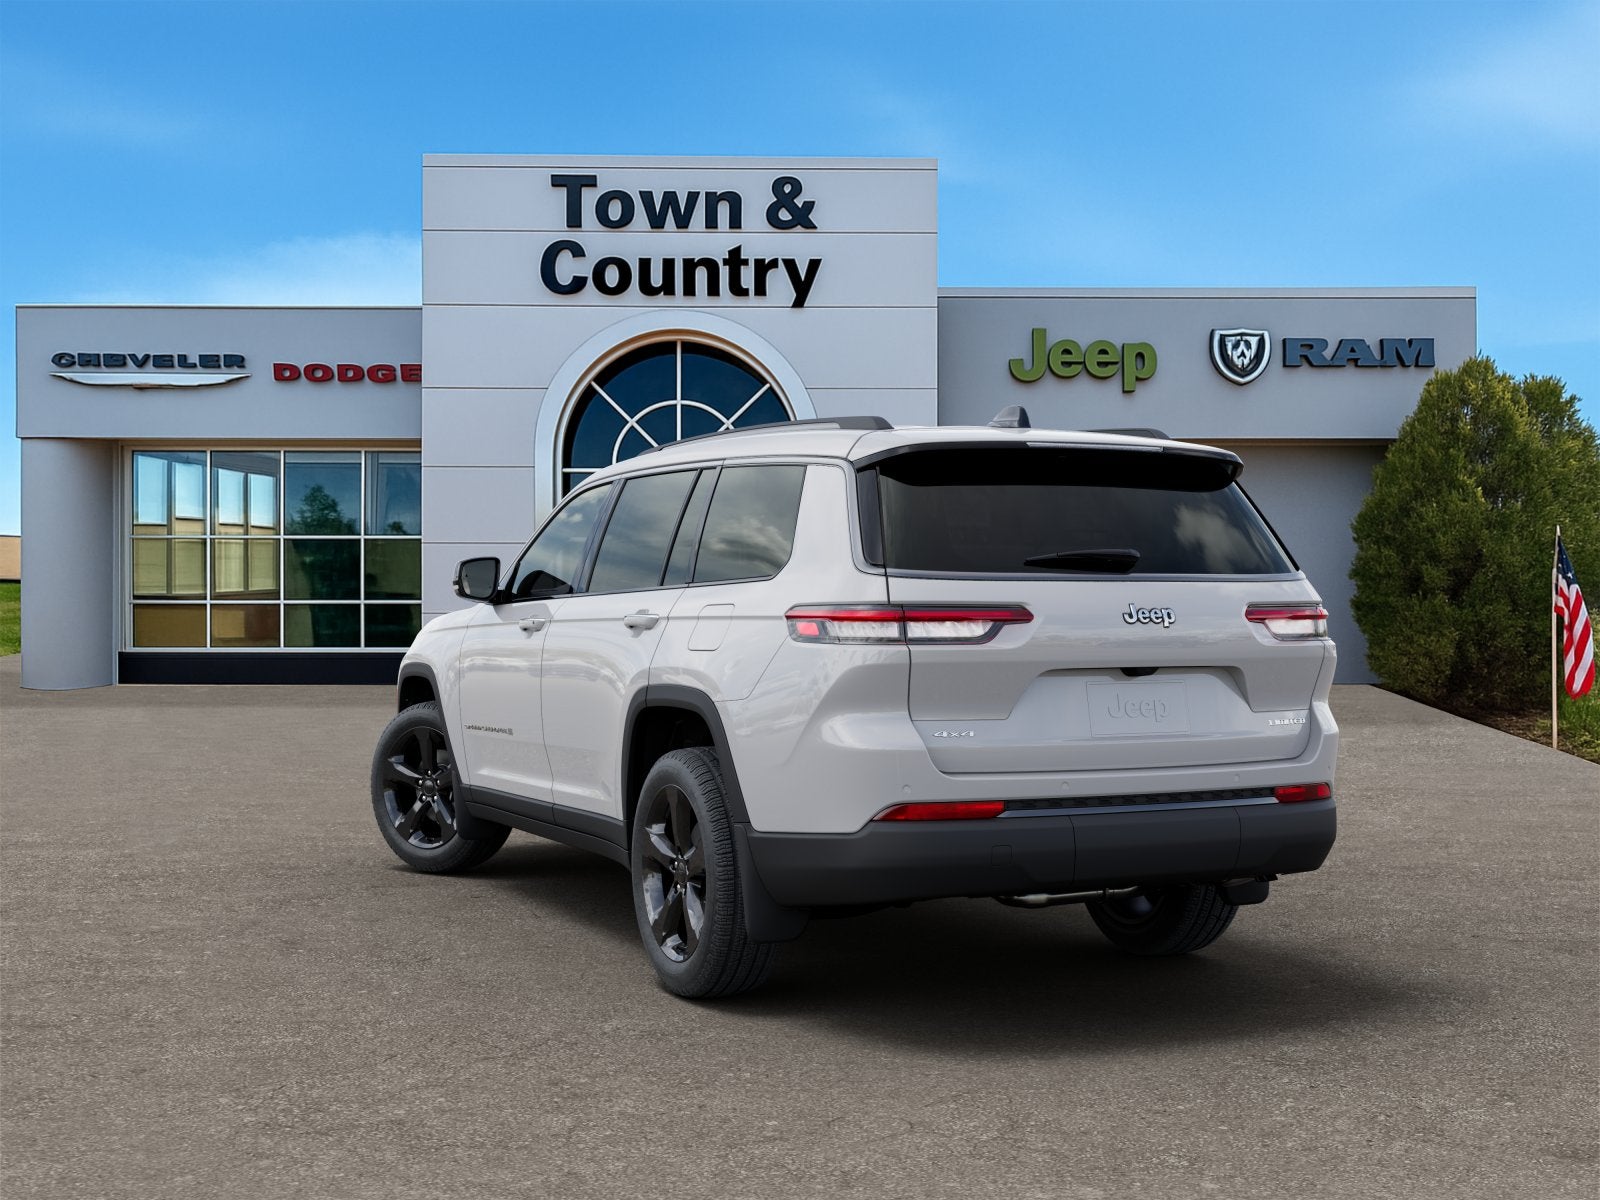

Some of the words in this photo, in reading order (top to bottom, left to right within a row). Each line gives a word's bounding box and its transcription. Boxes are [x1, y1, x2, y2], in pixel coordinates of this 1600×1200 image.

[550, 174, 743, 229] Town
[765, 175, 818, 230] &
[540, 239, 822, 309] Country
[1008, 327, 1158, 393] Jeep
[1282, 337, 1436, 368] RAM
[273, 362, 422, 383] DODGE
[1122, 602, 1176, 628] Jeep
[1107, 692, 1168, 723] Jeep
